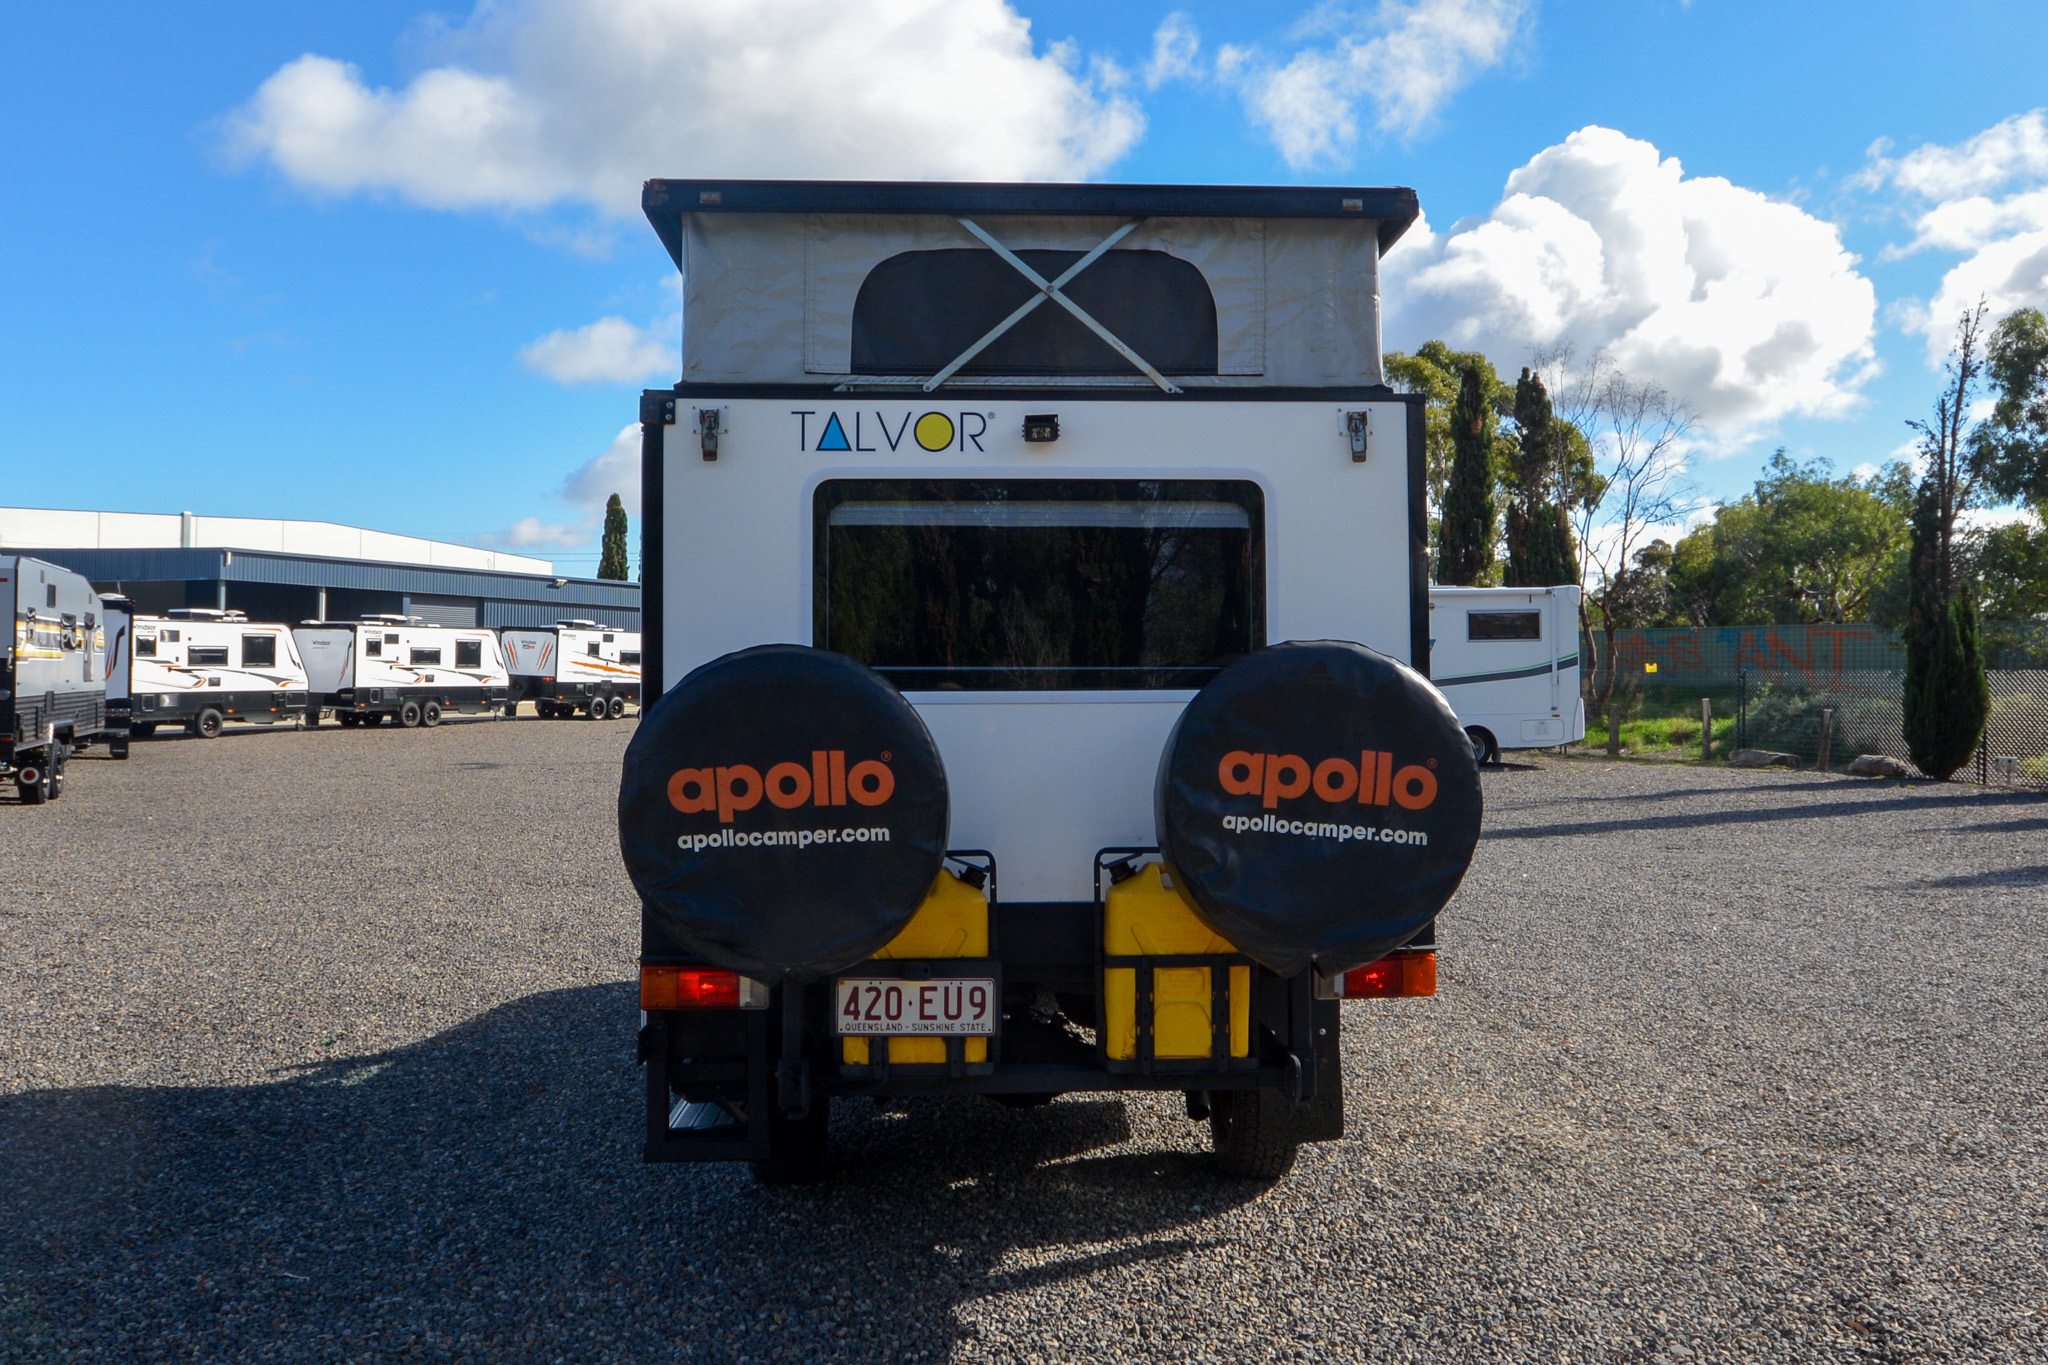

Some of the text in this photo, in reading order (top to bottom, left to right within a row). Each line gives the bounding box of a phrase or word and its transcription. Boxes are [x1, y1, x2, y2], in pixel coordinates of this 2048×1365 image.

[791, 411, 985, 452] TALVOR
[667, 750, 895, 823] apollo
[1218, 750, 1438, 810] apollo
[677, 827, 890, 852] apollocamper.com
[1222, 814, 1428, 846] apollocamper.com
[844, 1022, 903, 1032] QUEENSLAND
[911, 1022, 955, 1032] SUNSHINE
[960, 1022, 986, 1032] STATE
